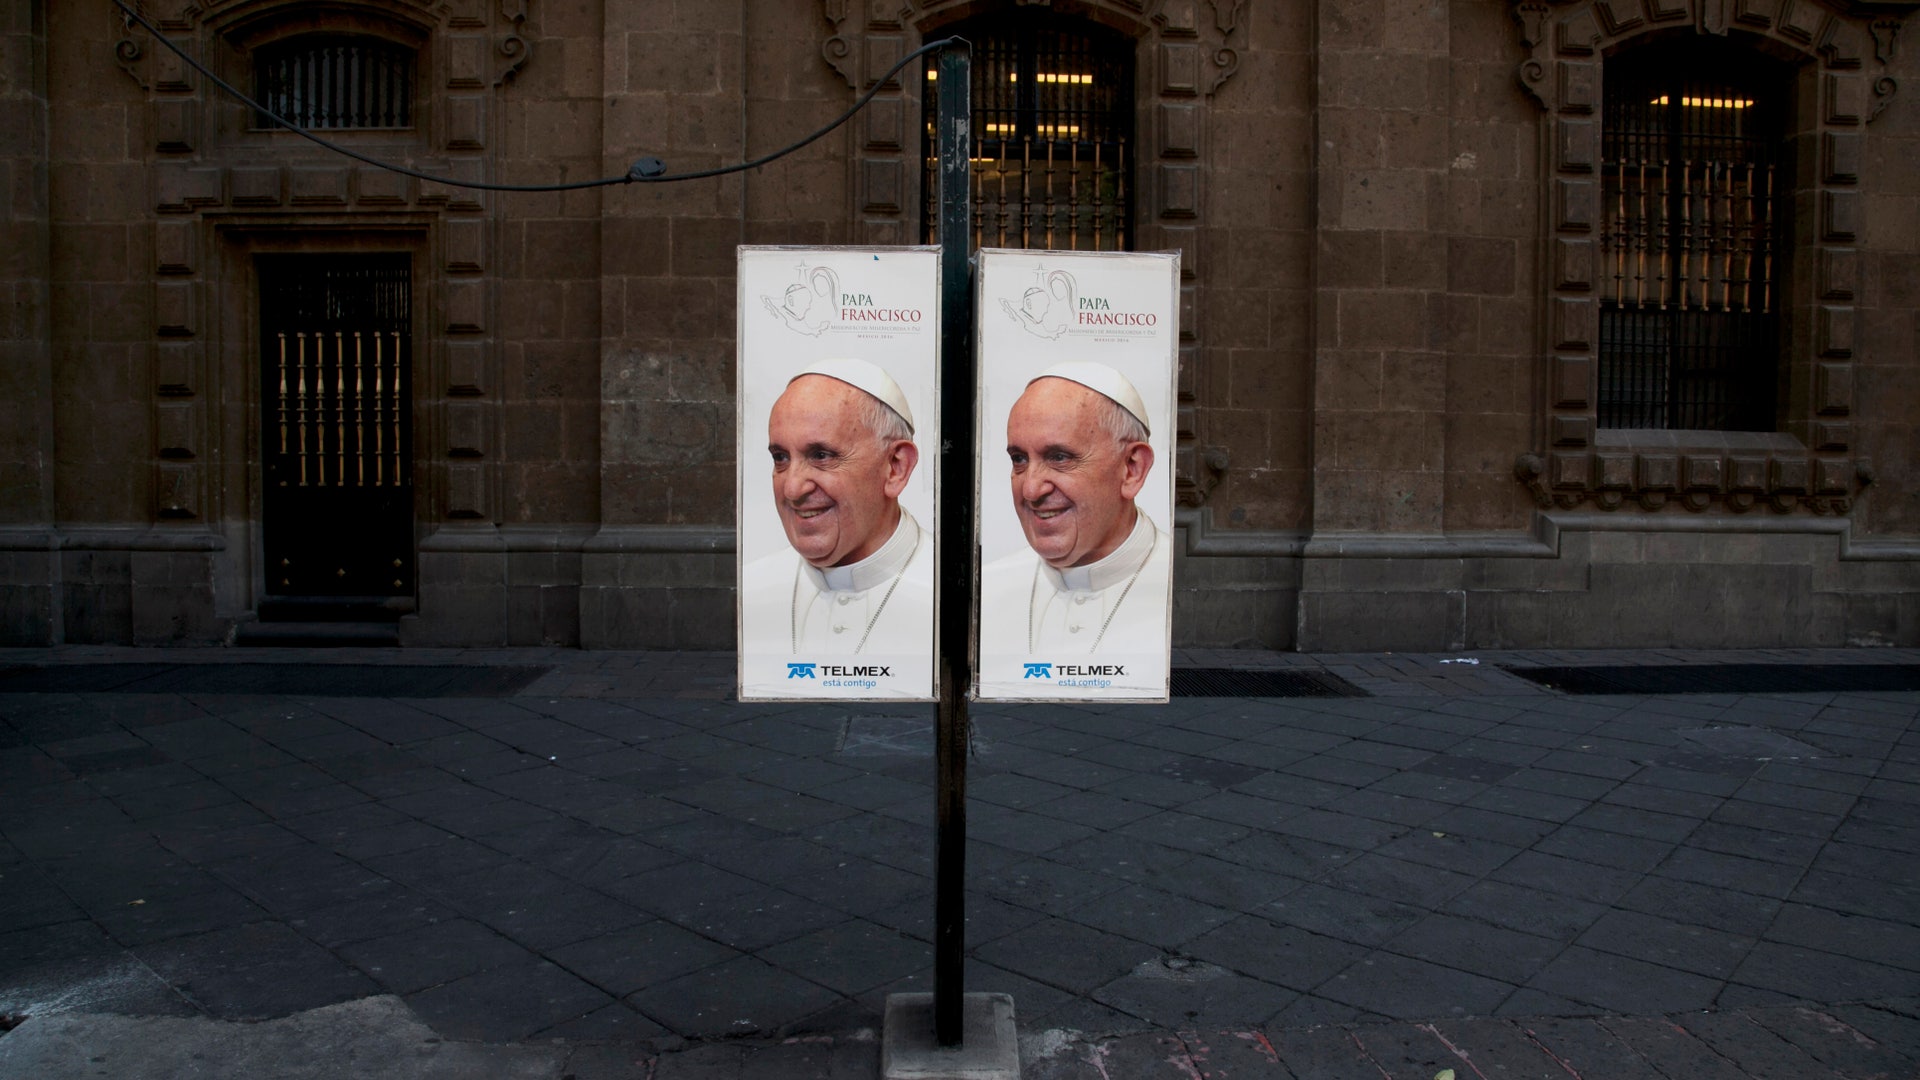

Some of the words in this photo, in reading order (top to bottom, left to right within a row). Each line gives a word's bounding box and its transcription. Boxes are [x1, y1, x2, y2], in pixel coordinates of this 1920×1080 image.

[842, 294, 874, 307] PAPA
[1079, 297, 1110, 310] PAPA
[841, 308, 922, 322] FRANCISCO
[1078, 312, 1157, 326] FRANCISCO
[820, 665, 891, 677] TELMEX
[1056, 665, 1125, 676] TELMEX
[822, 678, 841, 687] está
[843, 678, 877, 690] contigo
[1058, 677, 1076, 687] está
[1078, 677, 1111, 689] contigo
